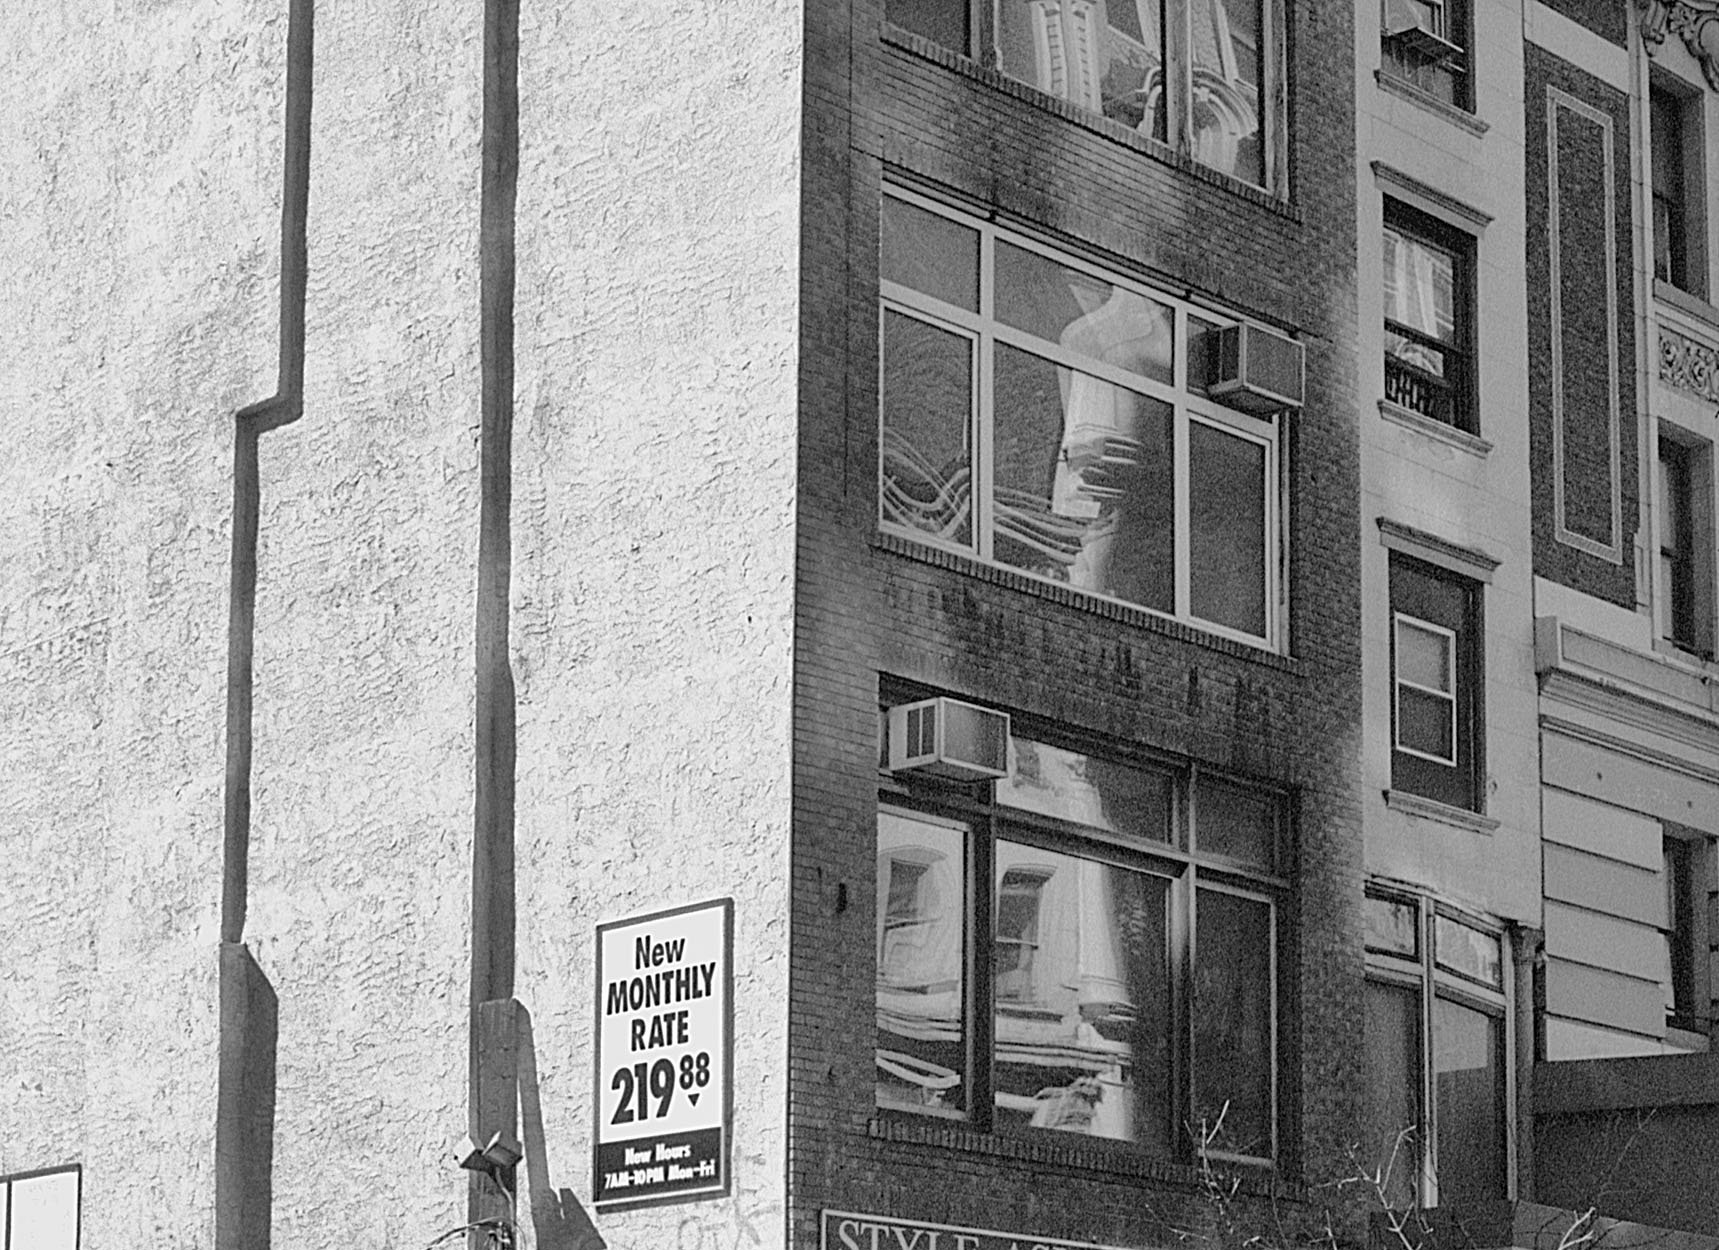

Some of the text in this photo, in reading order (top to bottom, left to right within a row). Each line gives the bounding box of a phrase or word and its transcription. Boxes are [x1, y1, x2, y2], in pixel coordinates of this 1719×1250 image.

[635, 934, 686, 970] New
[606, 961, 716, 1015] MONTHLY
[631, 1010, 689, 1051] RATE
[625, 1143, 691, 1166] New Hours
